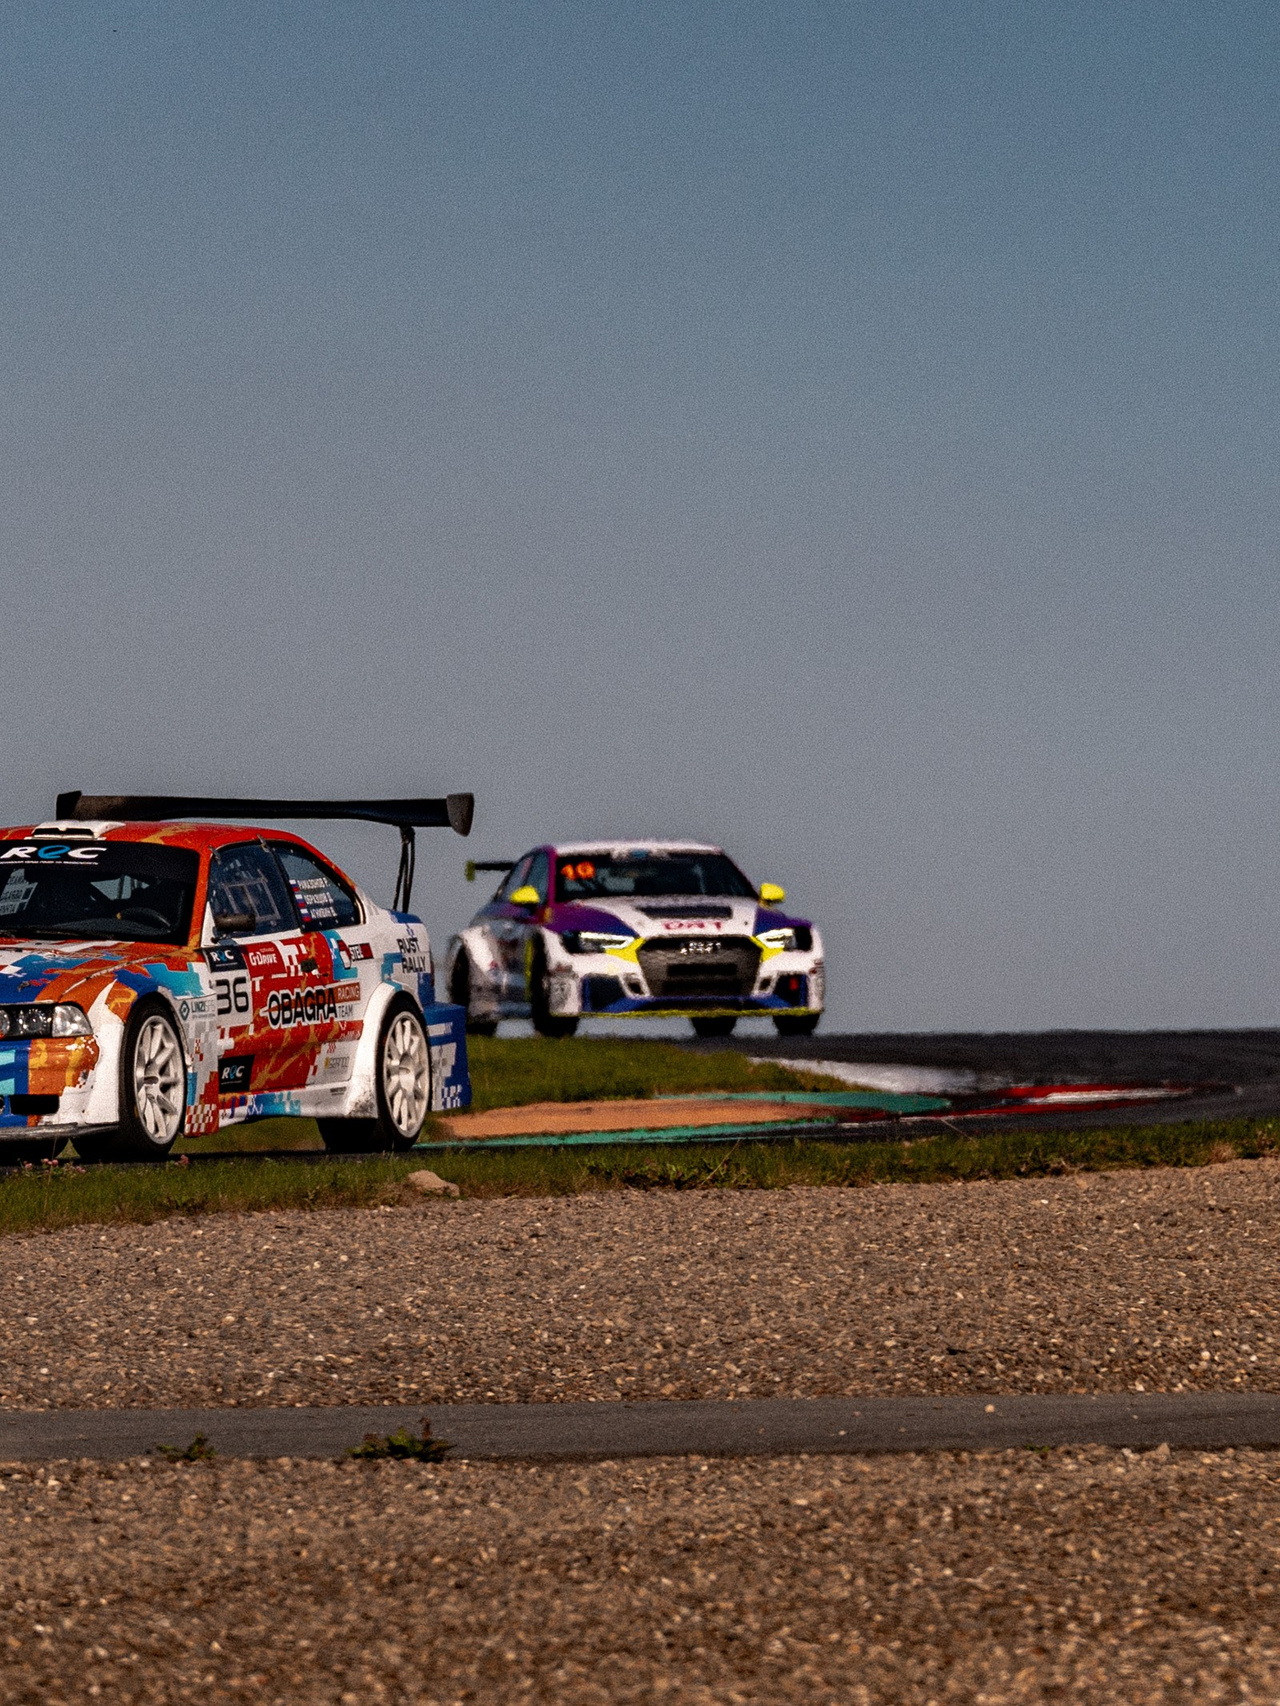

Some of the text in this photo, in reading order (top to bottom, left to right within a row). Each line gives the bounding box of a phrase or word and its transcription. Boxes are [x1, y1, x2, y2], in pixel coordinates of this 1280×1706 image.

[401, 956, 426, 974] RALLY
[215, 976, 249, 1016] 36
[268, 984, 360, 1027] OBAGRA RACING
[338, 1003, 353, 1018] TEAM
